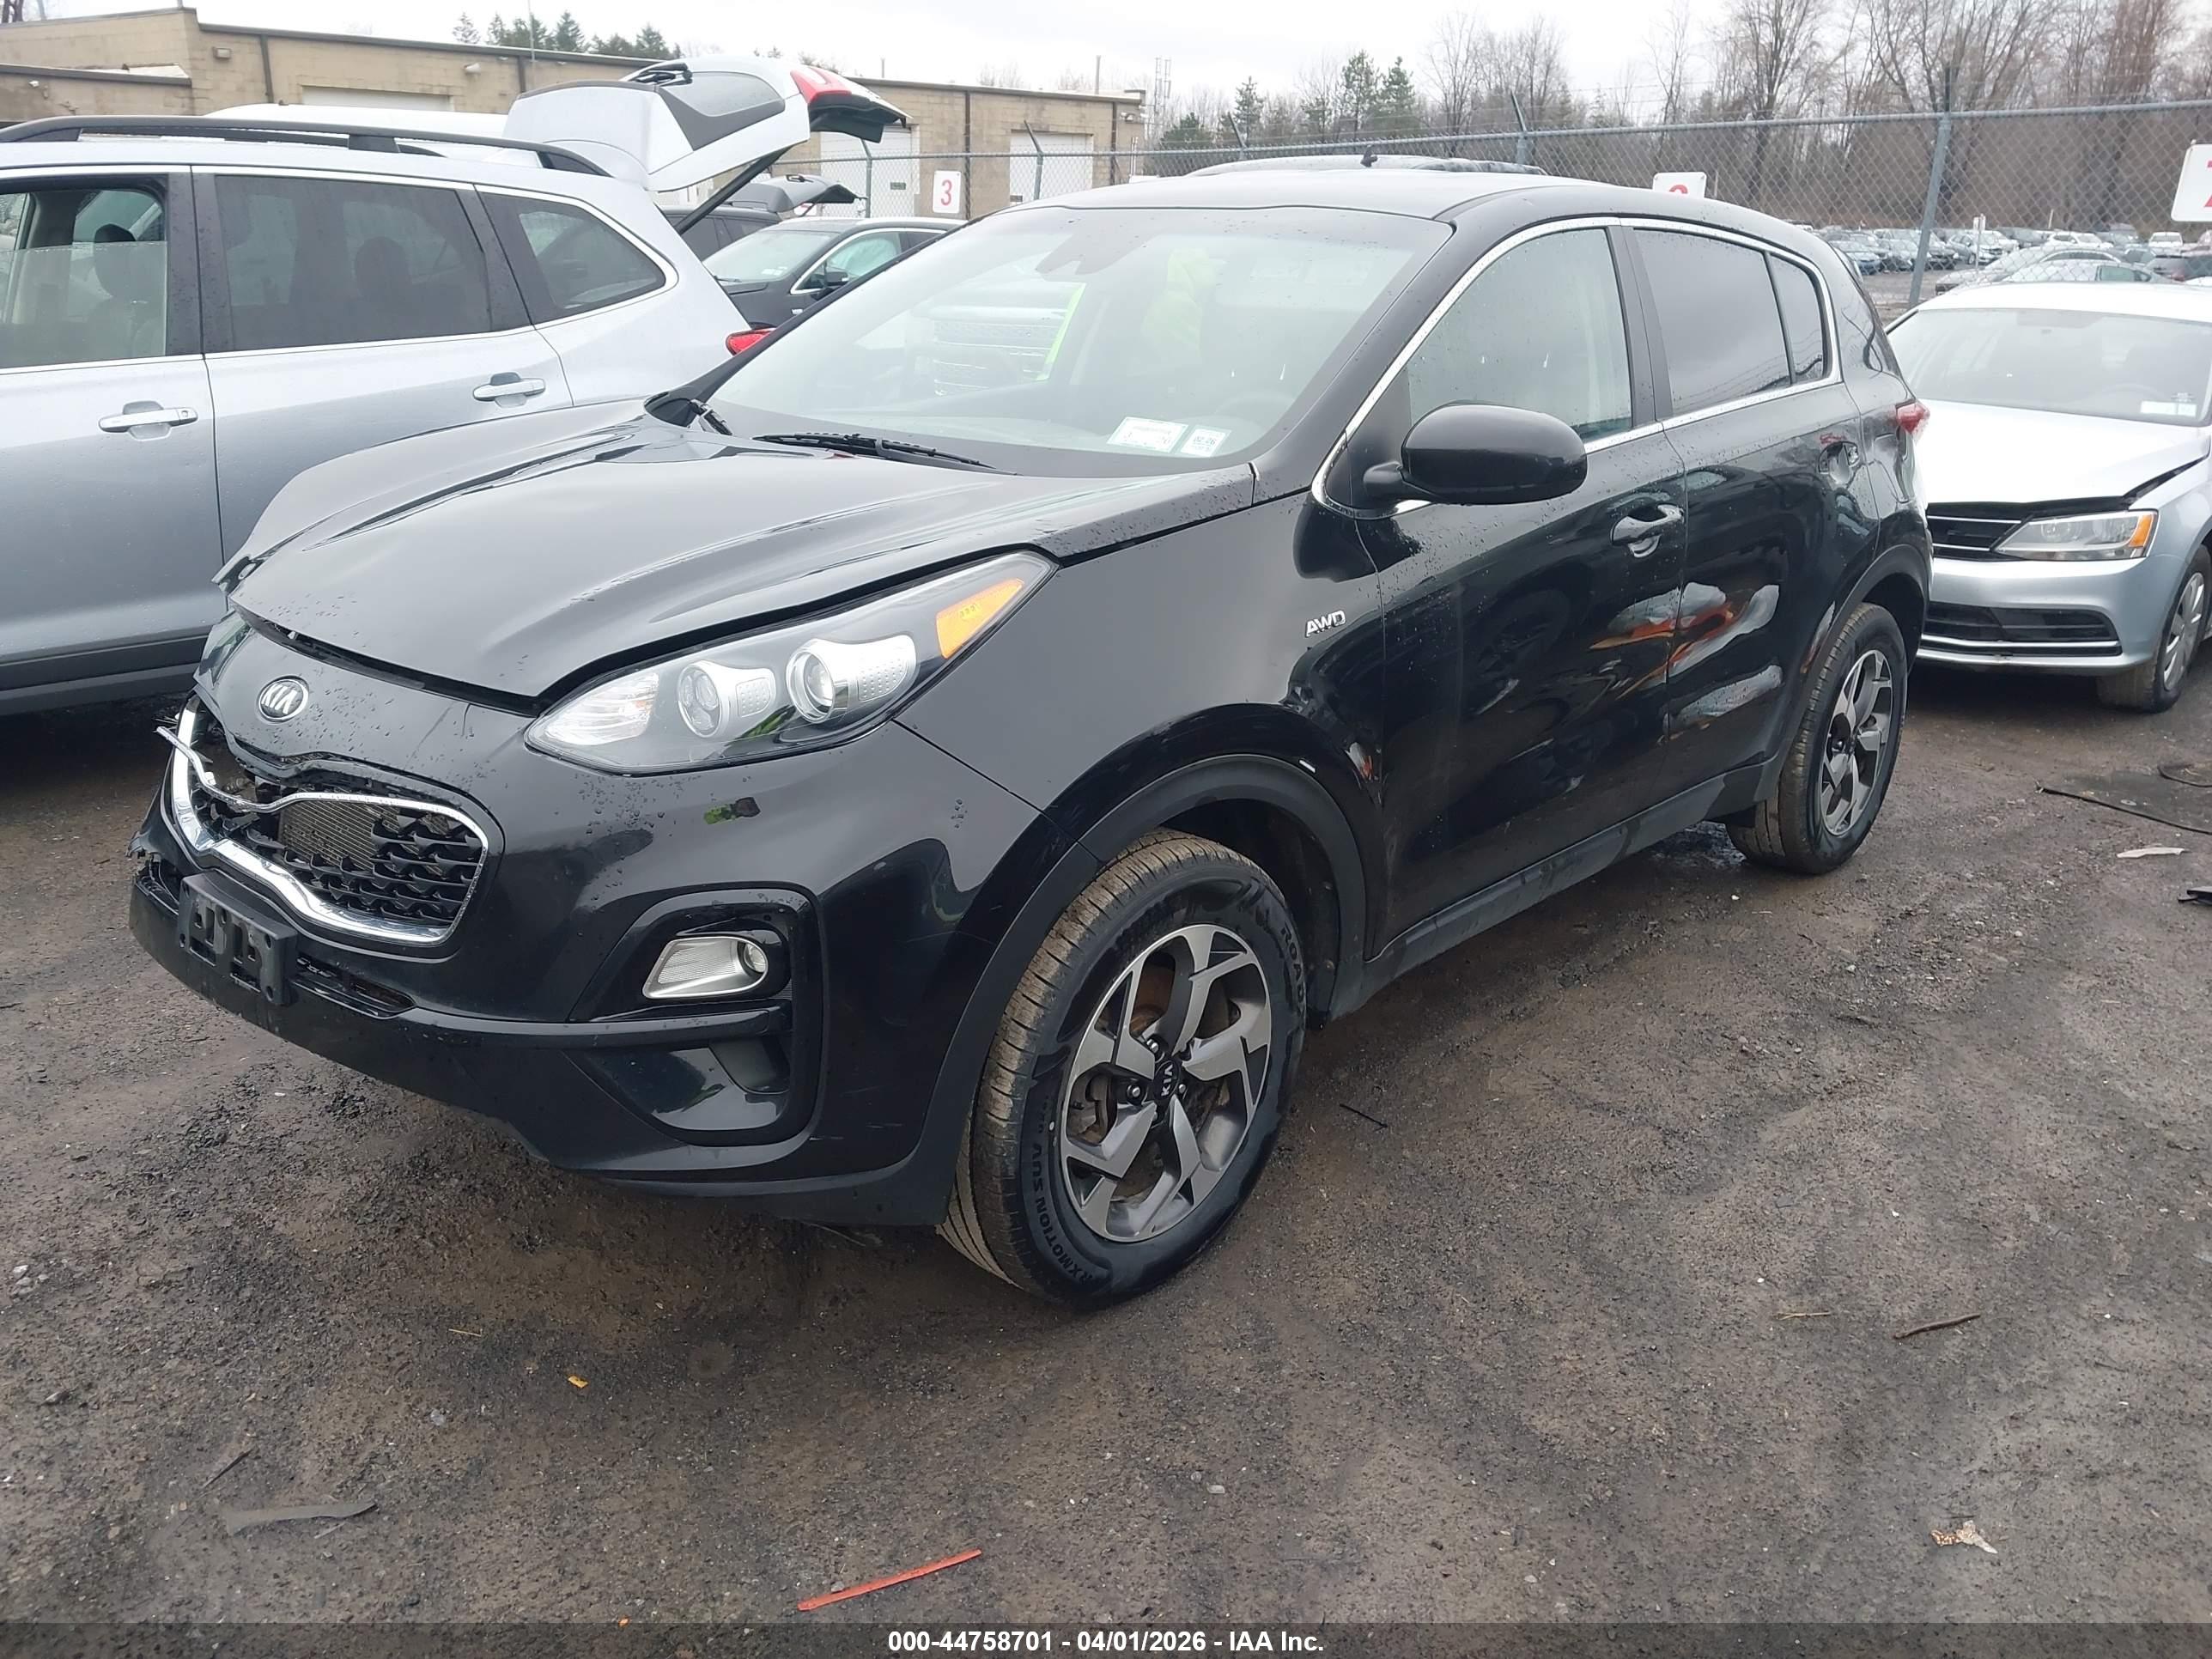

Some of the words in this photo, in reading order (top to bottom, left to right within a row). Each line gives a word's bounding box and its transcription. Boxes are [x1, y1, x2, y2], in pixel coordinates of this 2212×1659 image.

[941, 179, 952, 205] 3
[1305, 610, 1346, 637] AWD
[260, 683, 298, 714] KIA
[1161, 1064, 1174, 1097] KIA
[1031, 1142, 1045, 1193] SUV
